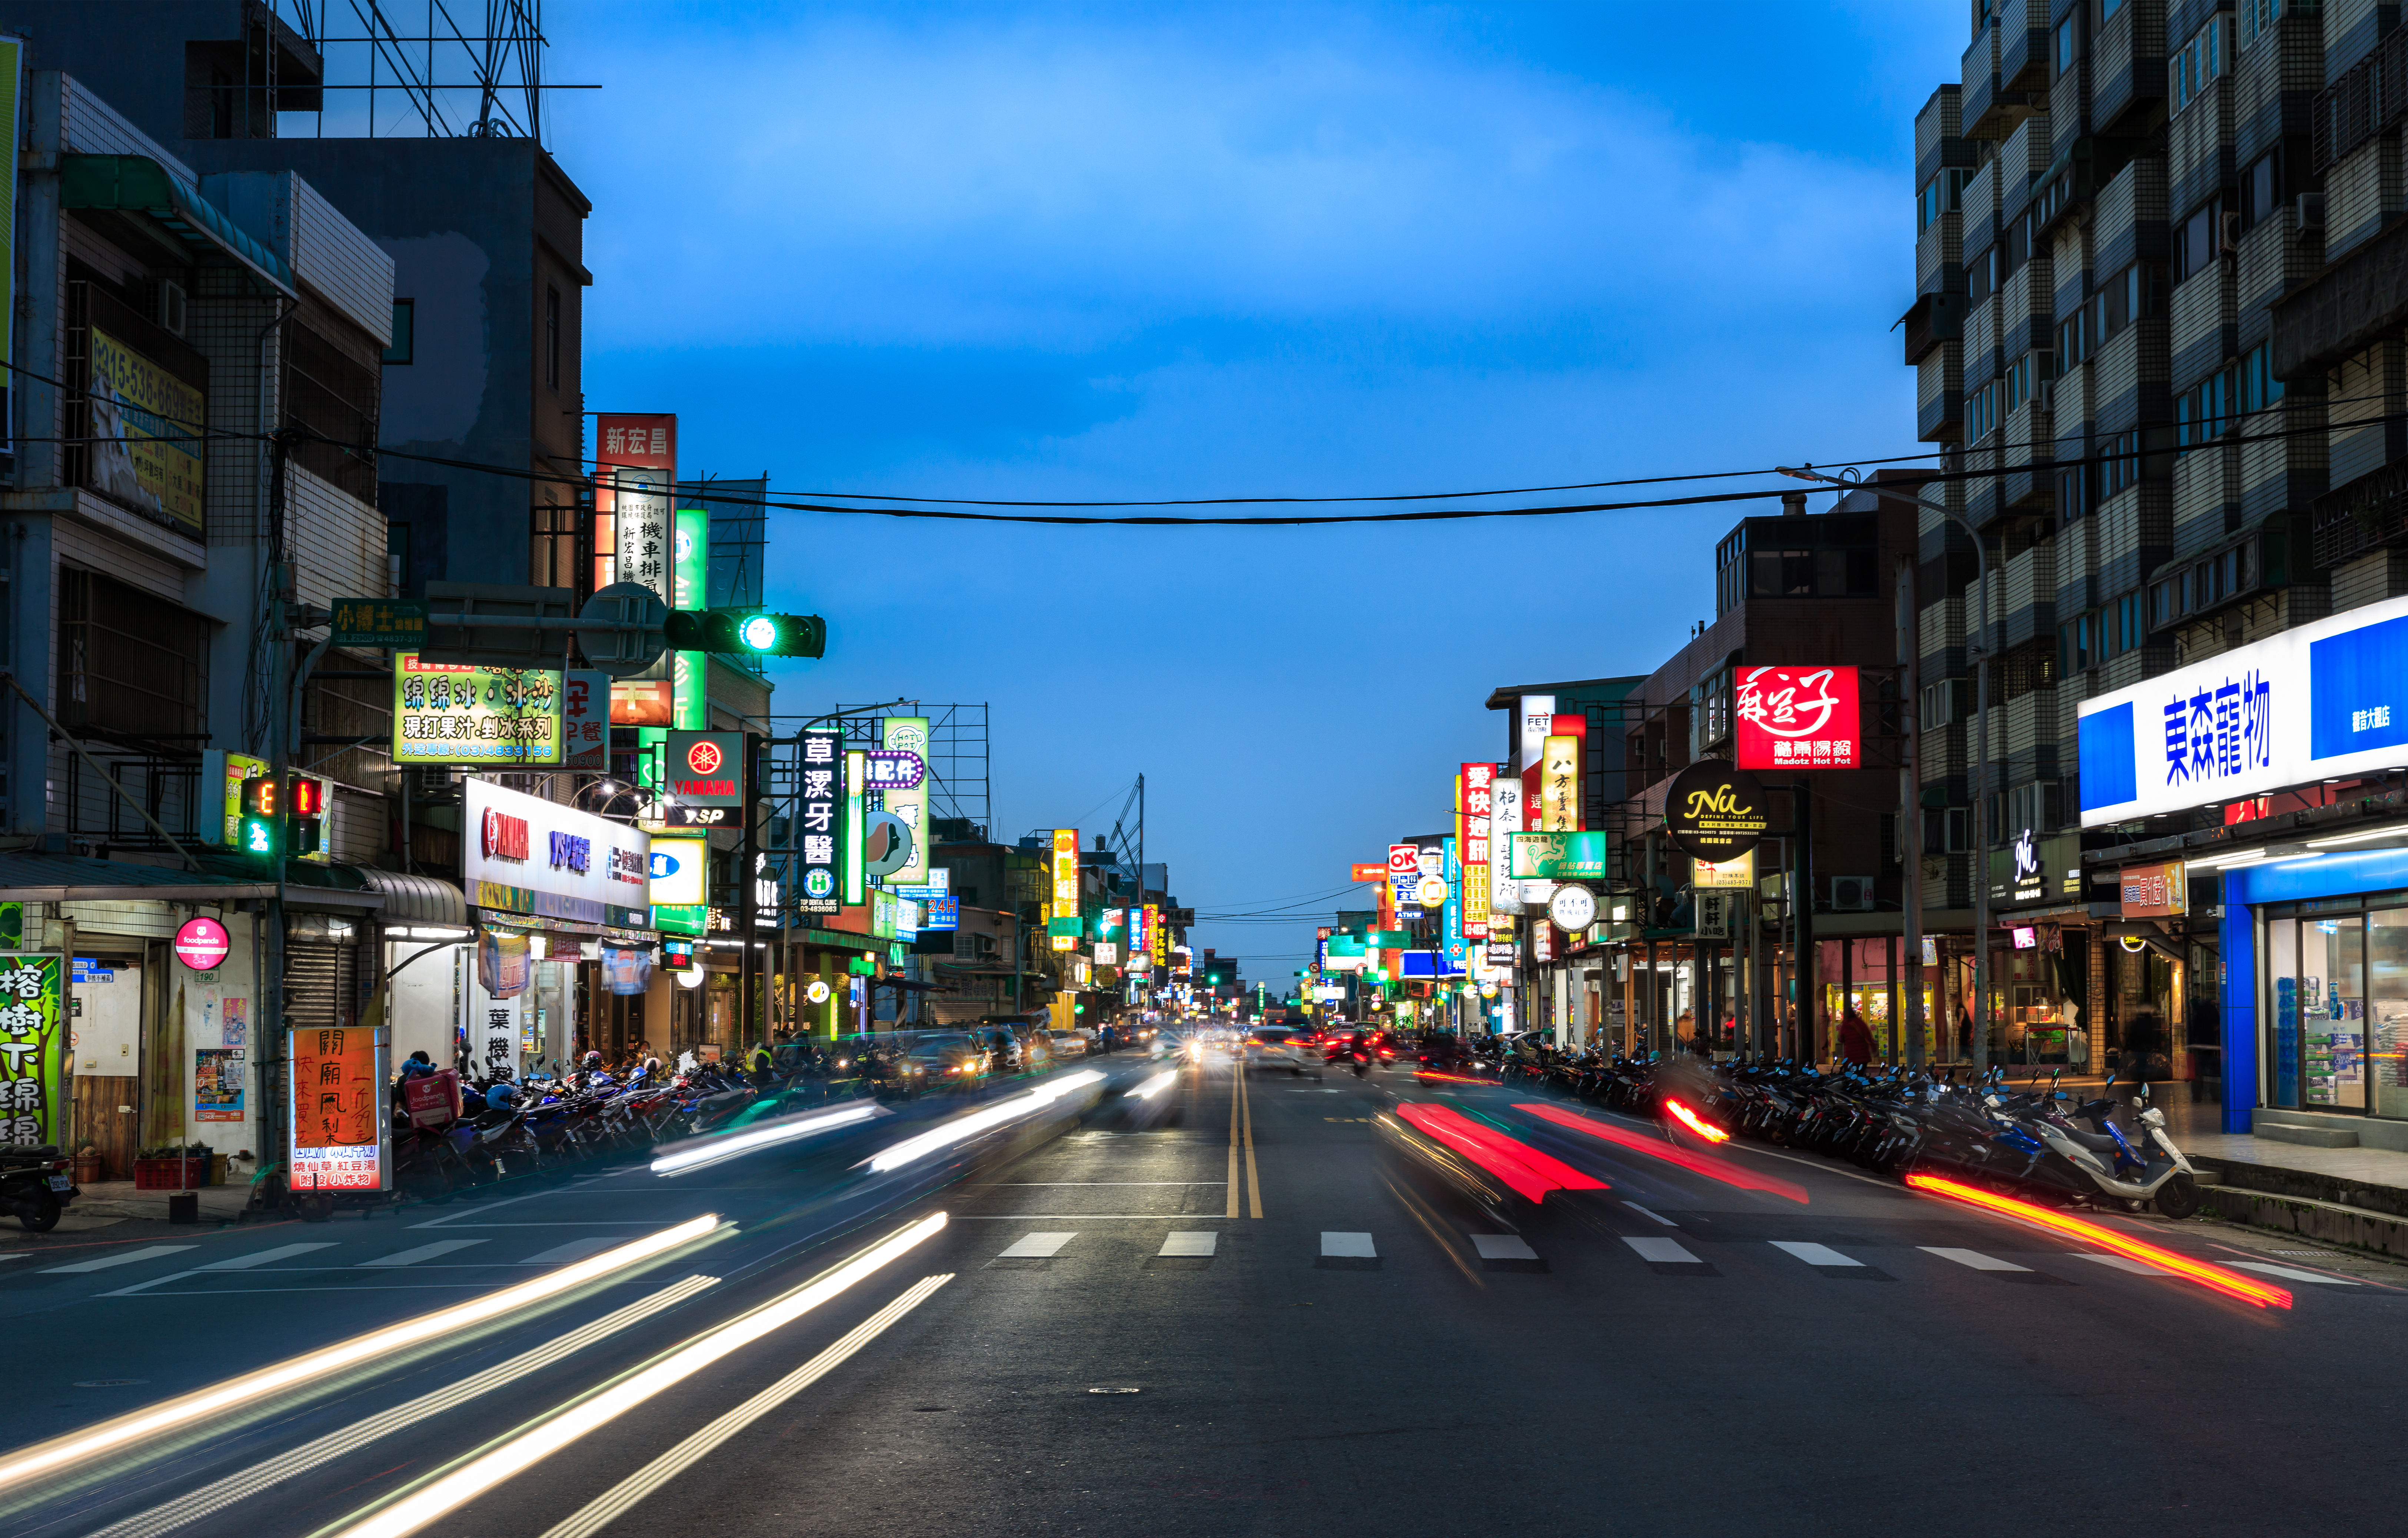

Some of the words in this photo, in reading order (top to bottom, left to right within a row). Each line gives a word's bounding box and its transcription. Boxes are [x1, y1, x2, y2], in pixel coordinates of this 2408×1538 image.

[606, 427, 666, 455] 新宏昌
[336, 605, 393, 631] 小博士
[2164, 668, 2269, 787] 東森寵物
[2352, 705, 2390, 733] 觀音大觀店
[675, 780, 735, 795] YAMAHA
[805, 737, 833, 864] 草漯牙醫
[1553, 760, 1571, 832] 八方雲集
[1684, 784, 1752, 818] Nu
[685, 809, 724, 824] YSP
[1468, 767, 1490, 861] 愛快通訊
[496, 812, 529, 860] YAMAHA
[1390, 850, 1416, 867] OK
[1558, 861, 1603, 870] 鍋貼專賣店
[1559, 898, 1588, 907] 可不可
[2124, 885, 2140, 903] 指定商品
[2140, 875, 2166, 906] 買1送1
[928, 900, 955, 913] 24H
[1704, 897, 1719, 926] 軒軒
[184, 936, 219, 945] foodpanda
[1701, 926, 1724, 936] 小吃
[1157, 928, 1166, 966] 寶島眼鏡
[294, 1161, 332, 1173] 燒仙草
[337, 1160, 376, 1171] 紅豆湯
[300, 1174, 326, 1187] 附設
[330, 1173, 370, 1185] 小炸物
